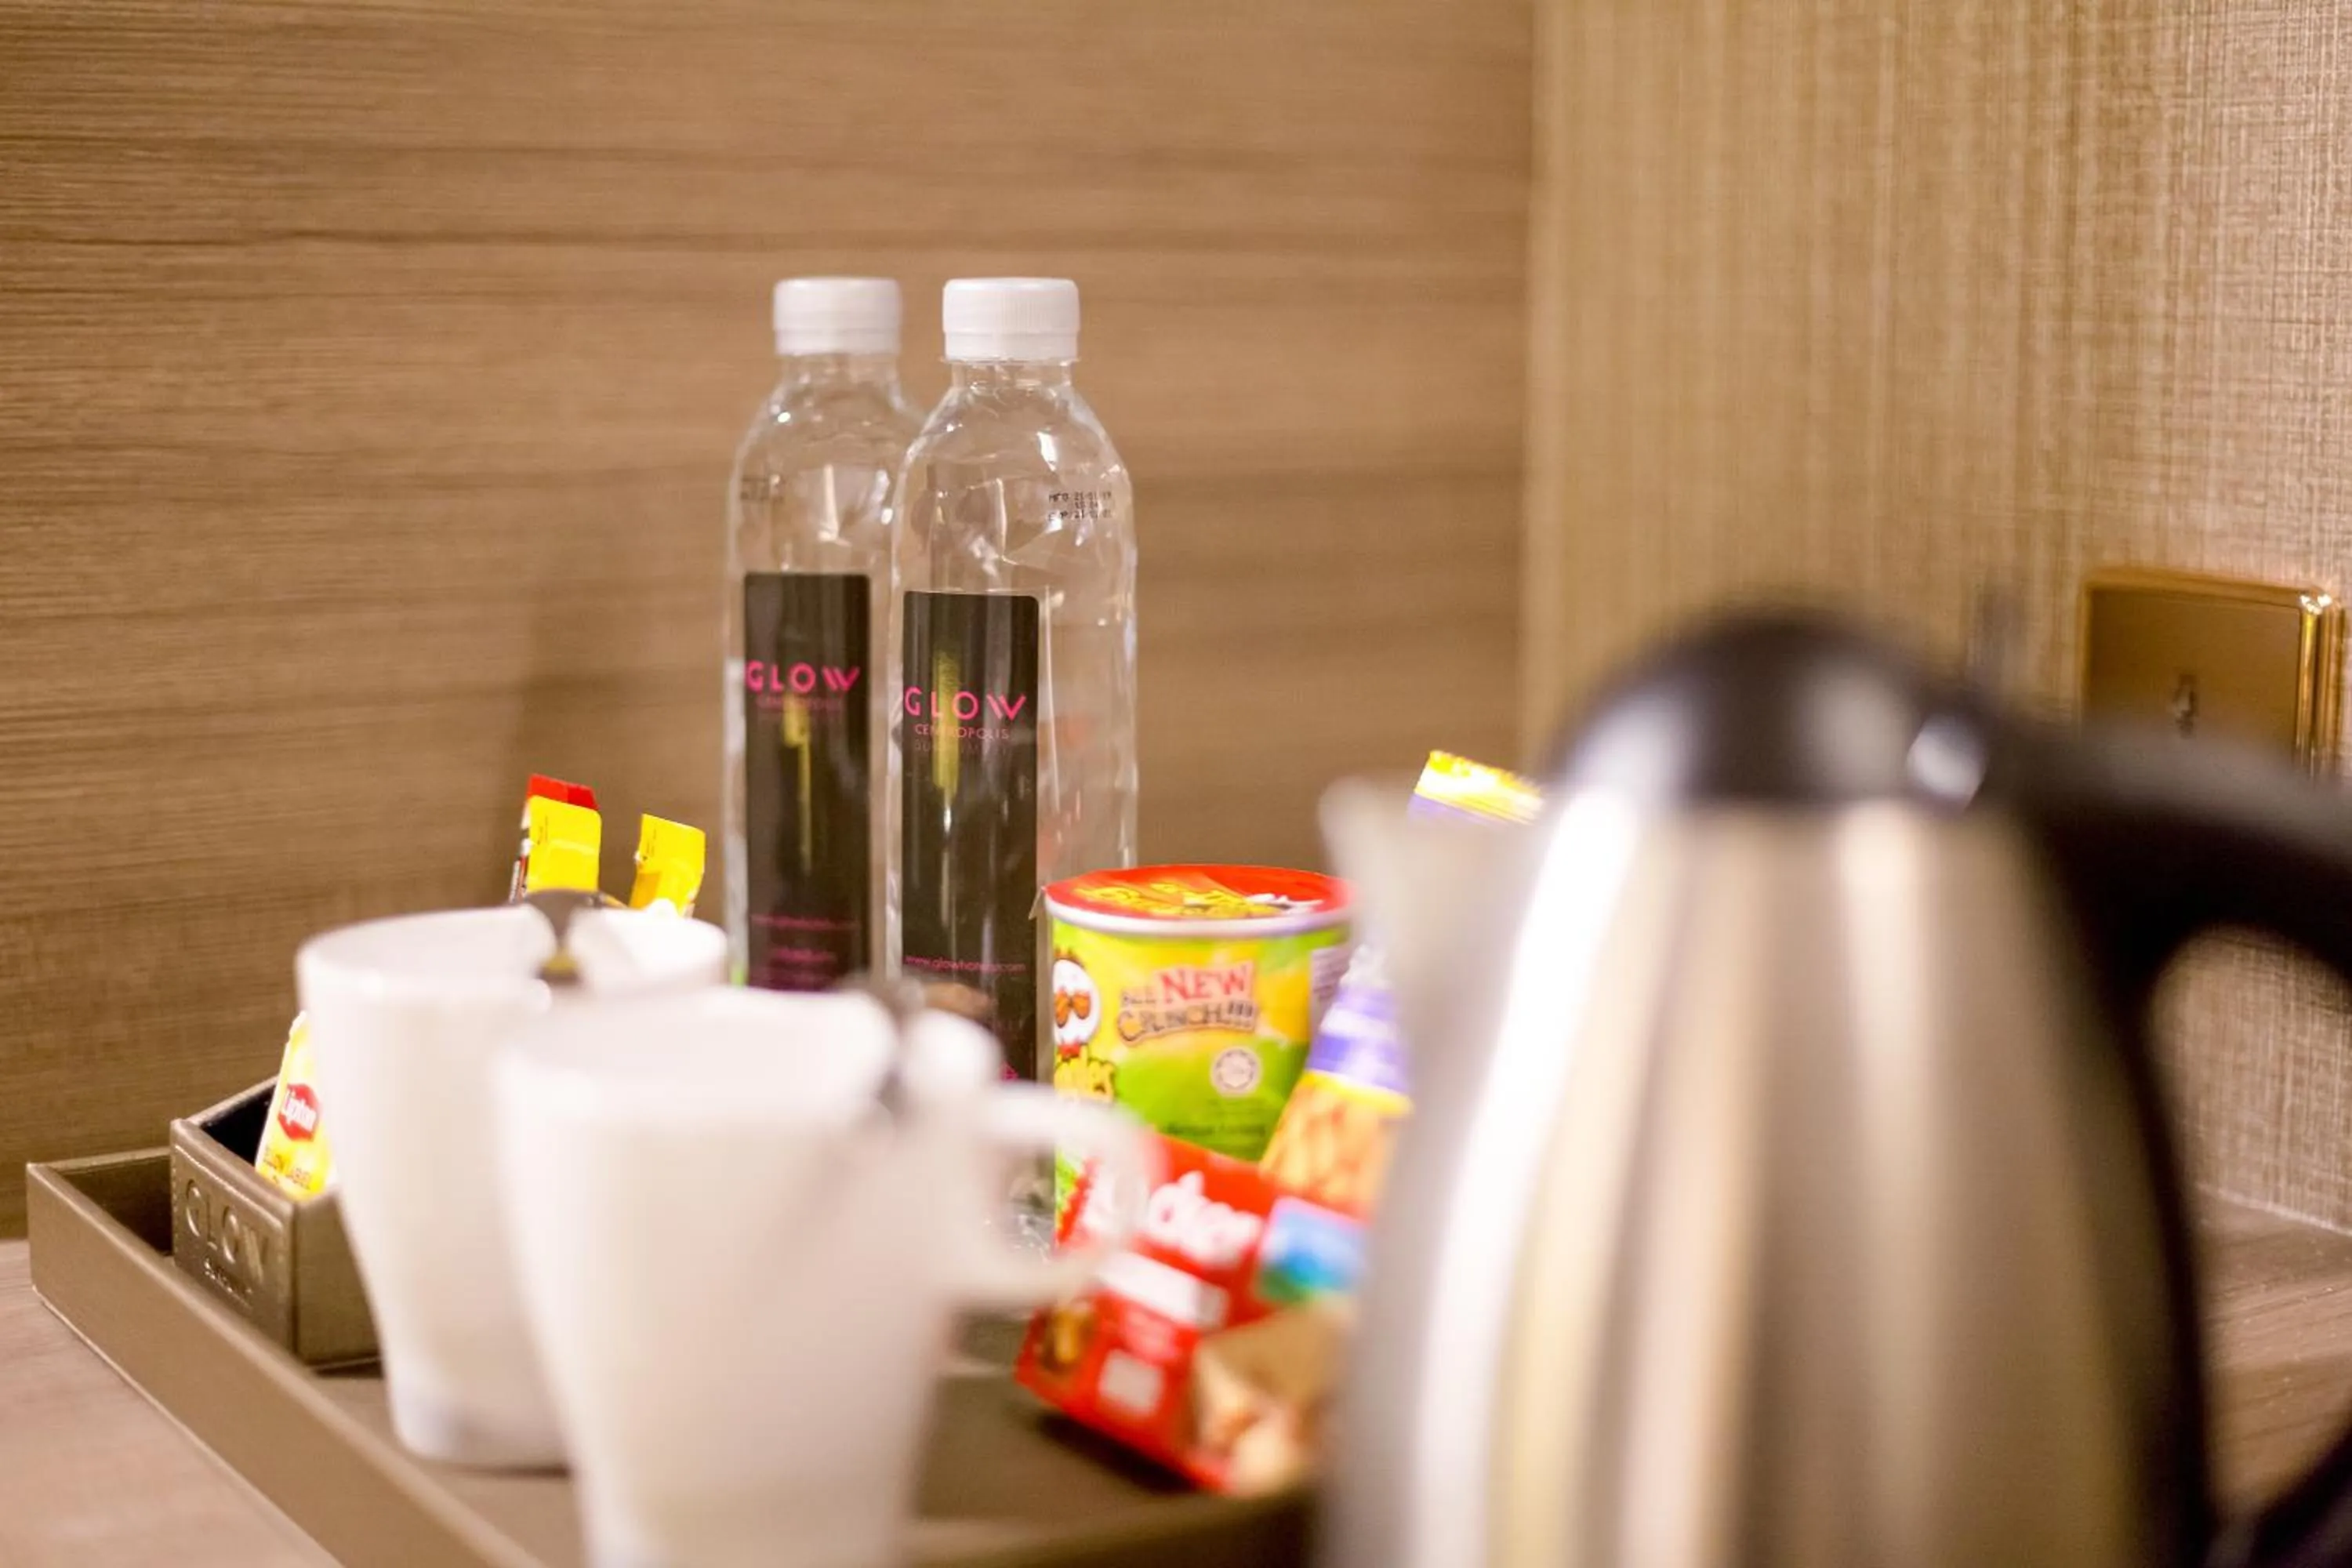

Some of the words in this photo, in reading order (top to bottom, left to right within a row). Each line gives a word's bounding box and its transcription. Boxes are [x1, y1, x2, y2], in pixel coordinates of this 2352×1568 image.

[745, 659, 860, 693] GLOW
[905, 686, 1027, 720] GLOW
[915, 722, 1010, 739] CENROPOLIS
[1161, 964, 1247, 1004] NEW
